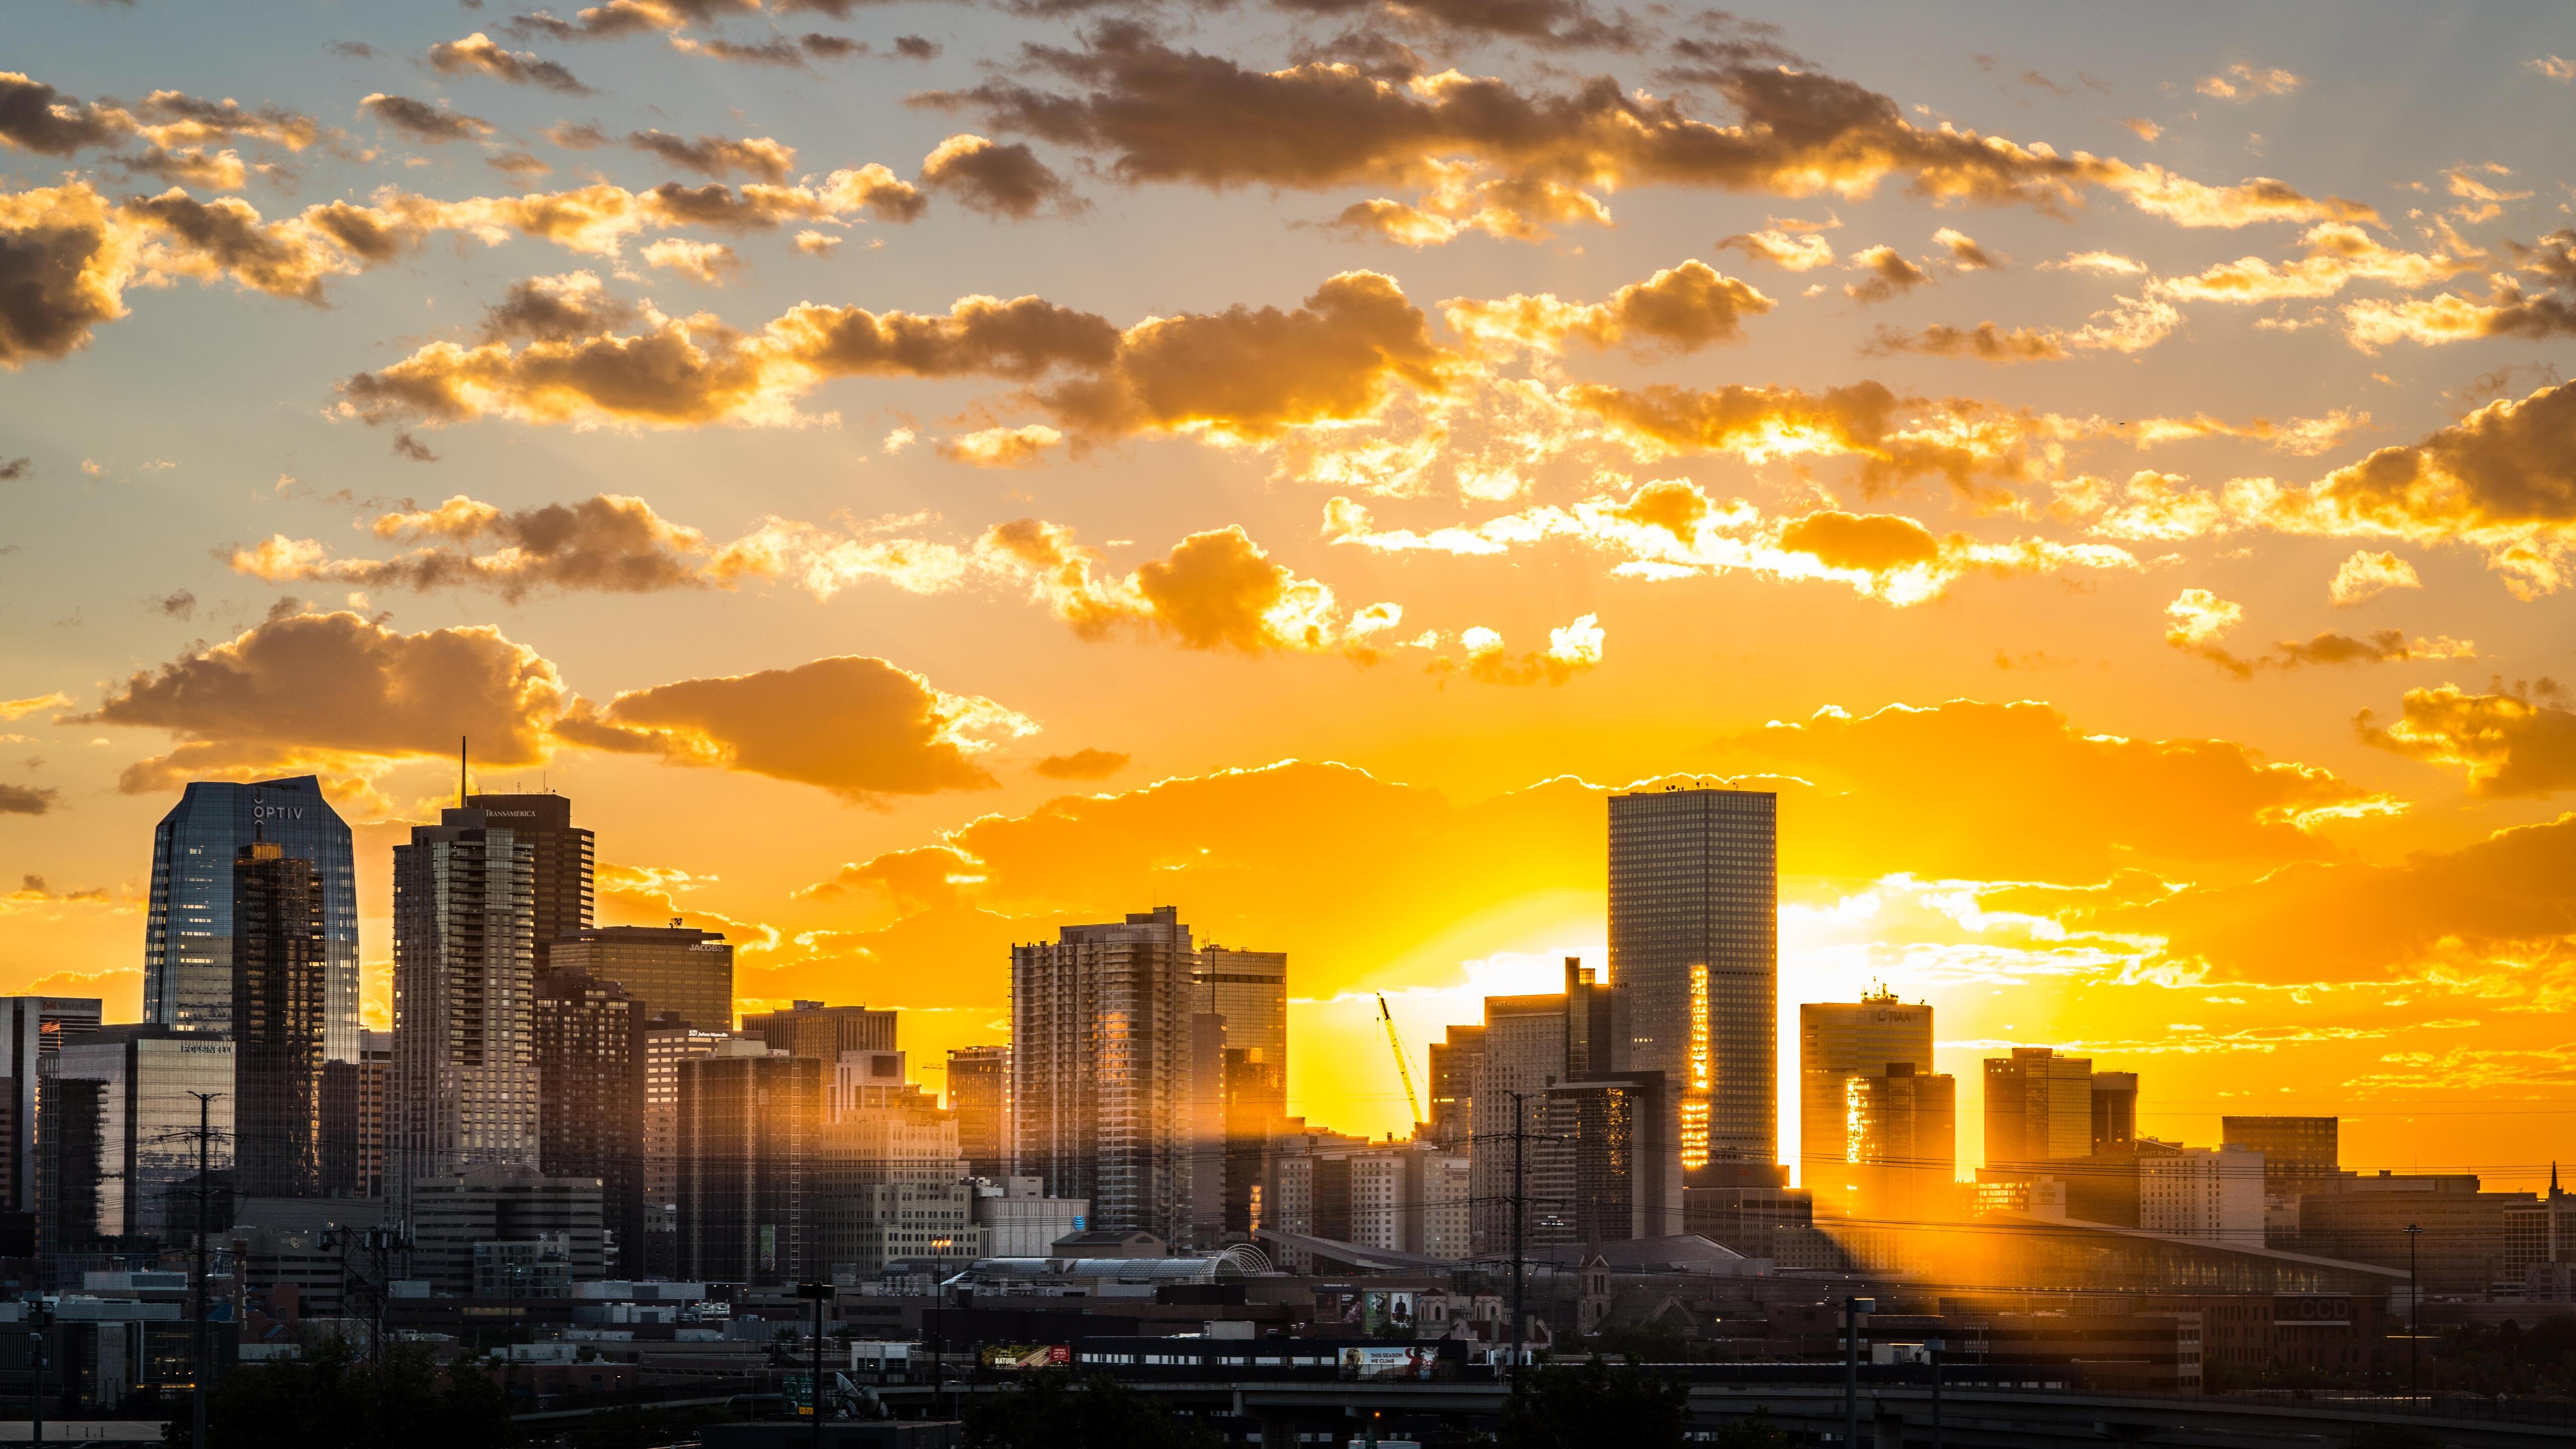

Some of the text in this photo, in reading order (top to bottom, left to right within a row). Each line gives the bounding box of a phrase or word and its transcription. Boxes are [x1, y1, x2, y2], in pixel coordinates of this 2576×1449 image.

[254, 806, 302, 820] OPTIV
[486, 809, 536, 817] TRANSAMERICA
[688, 944, 725, 952] JACOBS
[1888, 1011, 1911, 1022] TIAA
[2300, 1299, 2349, 1319] CCD
